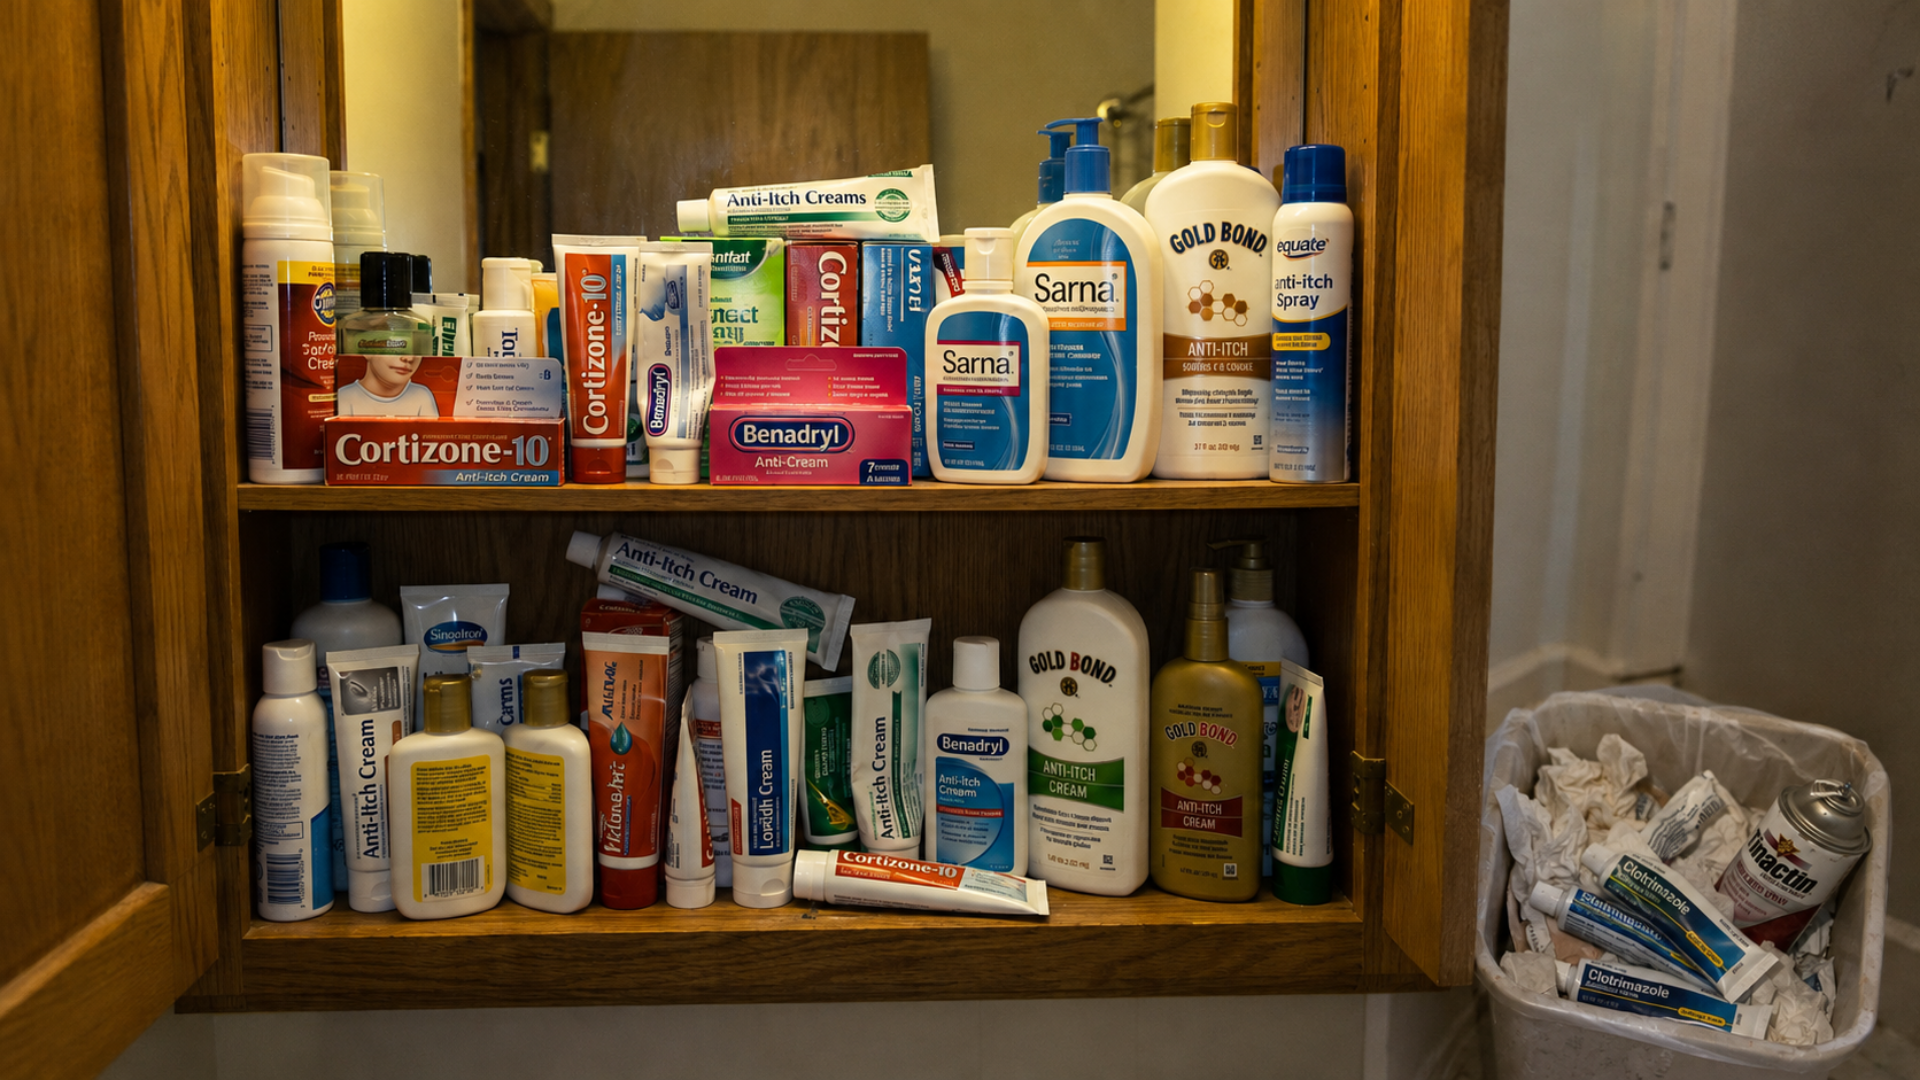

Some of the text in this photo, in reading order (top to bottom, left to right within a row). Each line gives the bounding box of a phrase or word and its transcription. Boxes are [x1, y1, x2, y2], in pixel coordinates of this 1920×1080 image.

[727, 191, 800, 208] Anti-Itch
[805, 190, 867, 205] Creams
[1169, 222, 1216, 254] GOLD
[1277, 238, 1326, 255] equate
[1275, 274, 1333, 290] anti-itch
[818, 251, 848, 347] Cortiz
[1277, 293, 1320, 310] Spray
[581, 274, 609, 435] Cortizone-10
[1188, 342, 1248, 356] ANTI-ITCH
[744, 425, 839, 452] Benadryl
[335, 433, 549, 466] Cortizone-10
[755, 456, 829, 468] Anti-Cream
[511, 472, 549, 482] Cream
[615, 541, 758, 604] Anti-Itch Cream
[1029, 651, 1066, 675] GOLD
[1165, 722, 1196, 741] GOLD
[942, 736, 1003, 755] Benadryl
[759, 750, 773, 795] Cream
[872, 716, 895, 840] Anti-Itch Cream
[1043, 760, 1096, 781] ANTI-ITCH
[359, 719, 380, 858] Anti-Itch Cream
[1049, 780, 1088, 798] CREAM
[1177, 800, 1222, 815] ANTI-ITCH
[1183, 816, 1215, 829] CREAM
[843, 851, 958, 878] Cortizone-10
[1588, 969, 1670, 998] Clotrimazole
